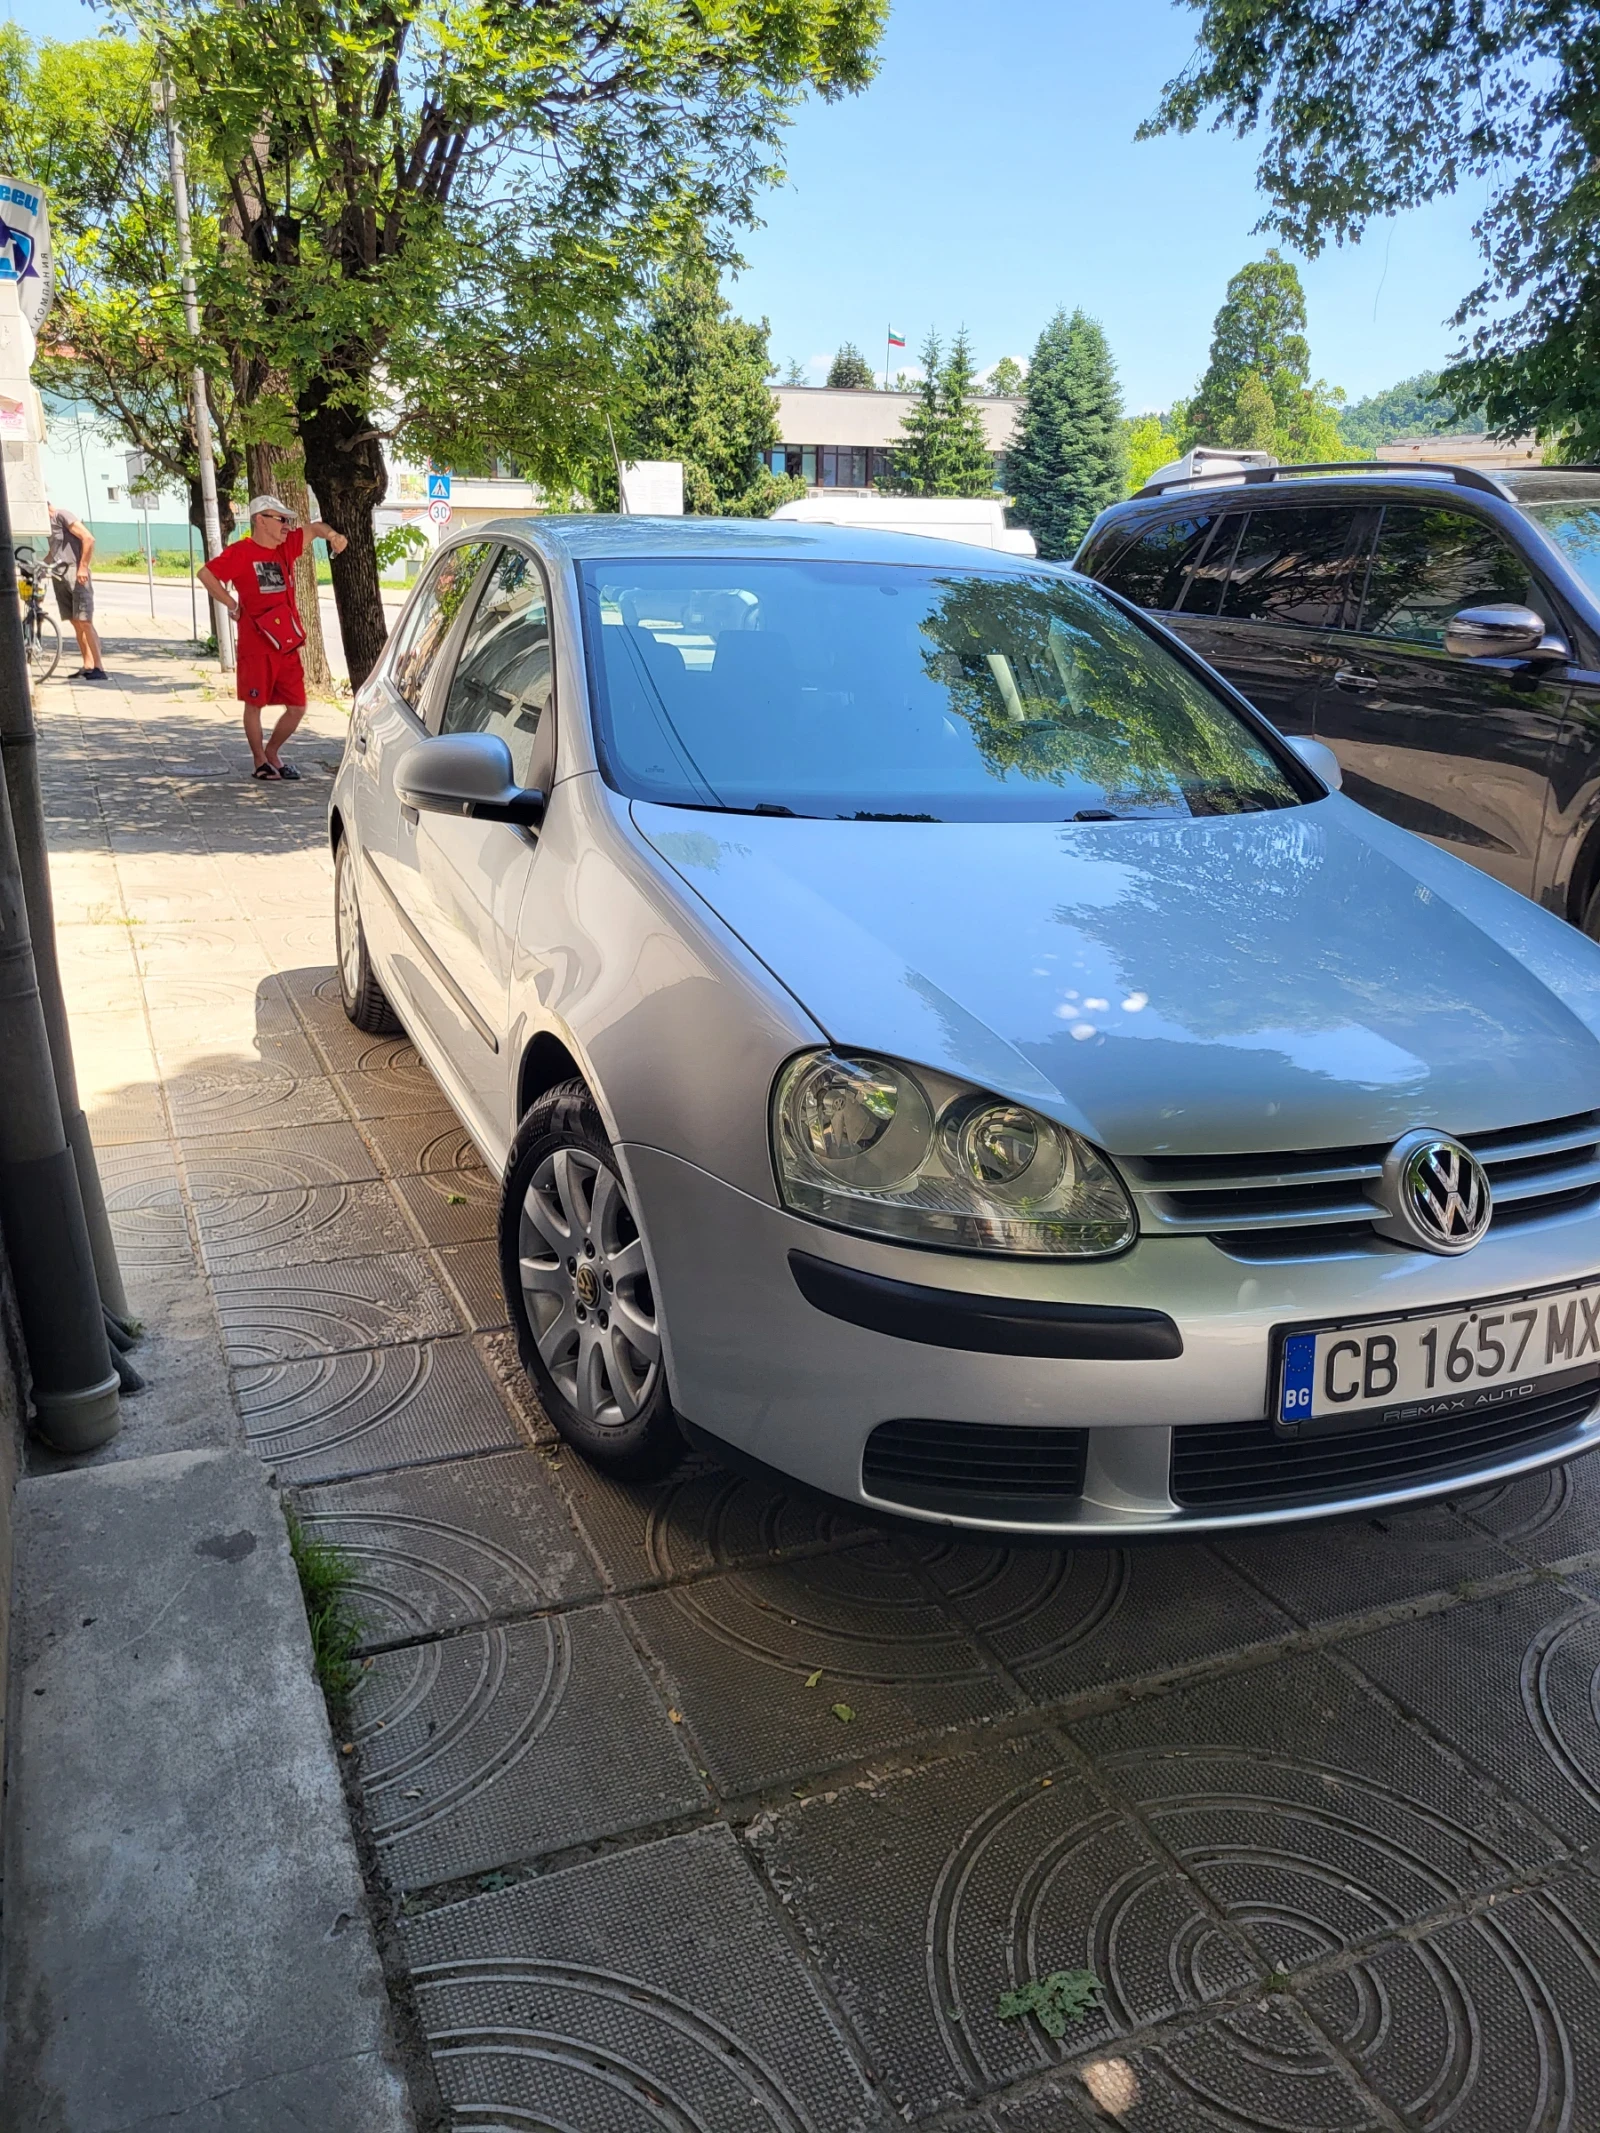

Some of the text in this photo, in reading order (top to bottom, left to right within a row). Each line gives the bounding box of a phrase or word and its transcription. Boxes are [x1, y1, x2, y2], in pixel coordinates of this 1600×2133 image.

[33, 252, 51, 323] КОМПАНИЯ
[433, 506, 447, 519] 30
[1406, 1142, 1488, 1242] VW
[1324, 1294, 1600, 1402] CB 1657 MX
[1285, 1387, 1309, 1408] BG
[1383, 1384, 1533, 1422] REMAX AUTO
